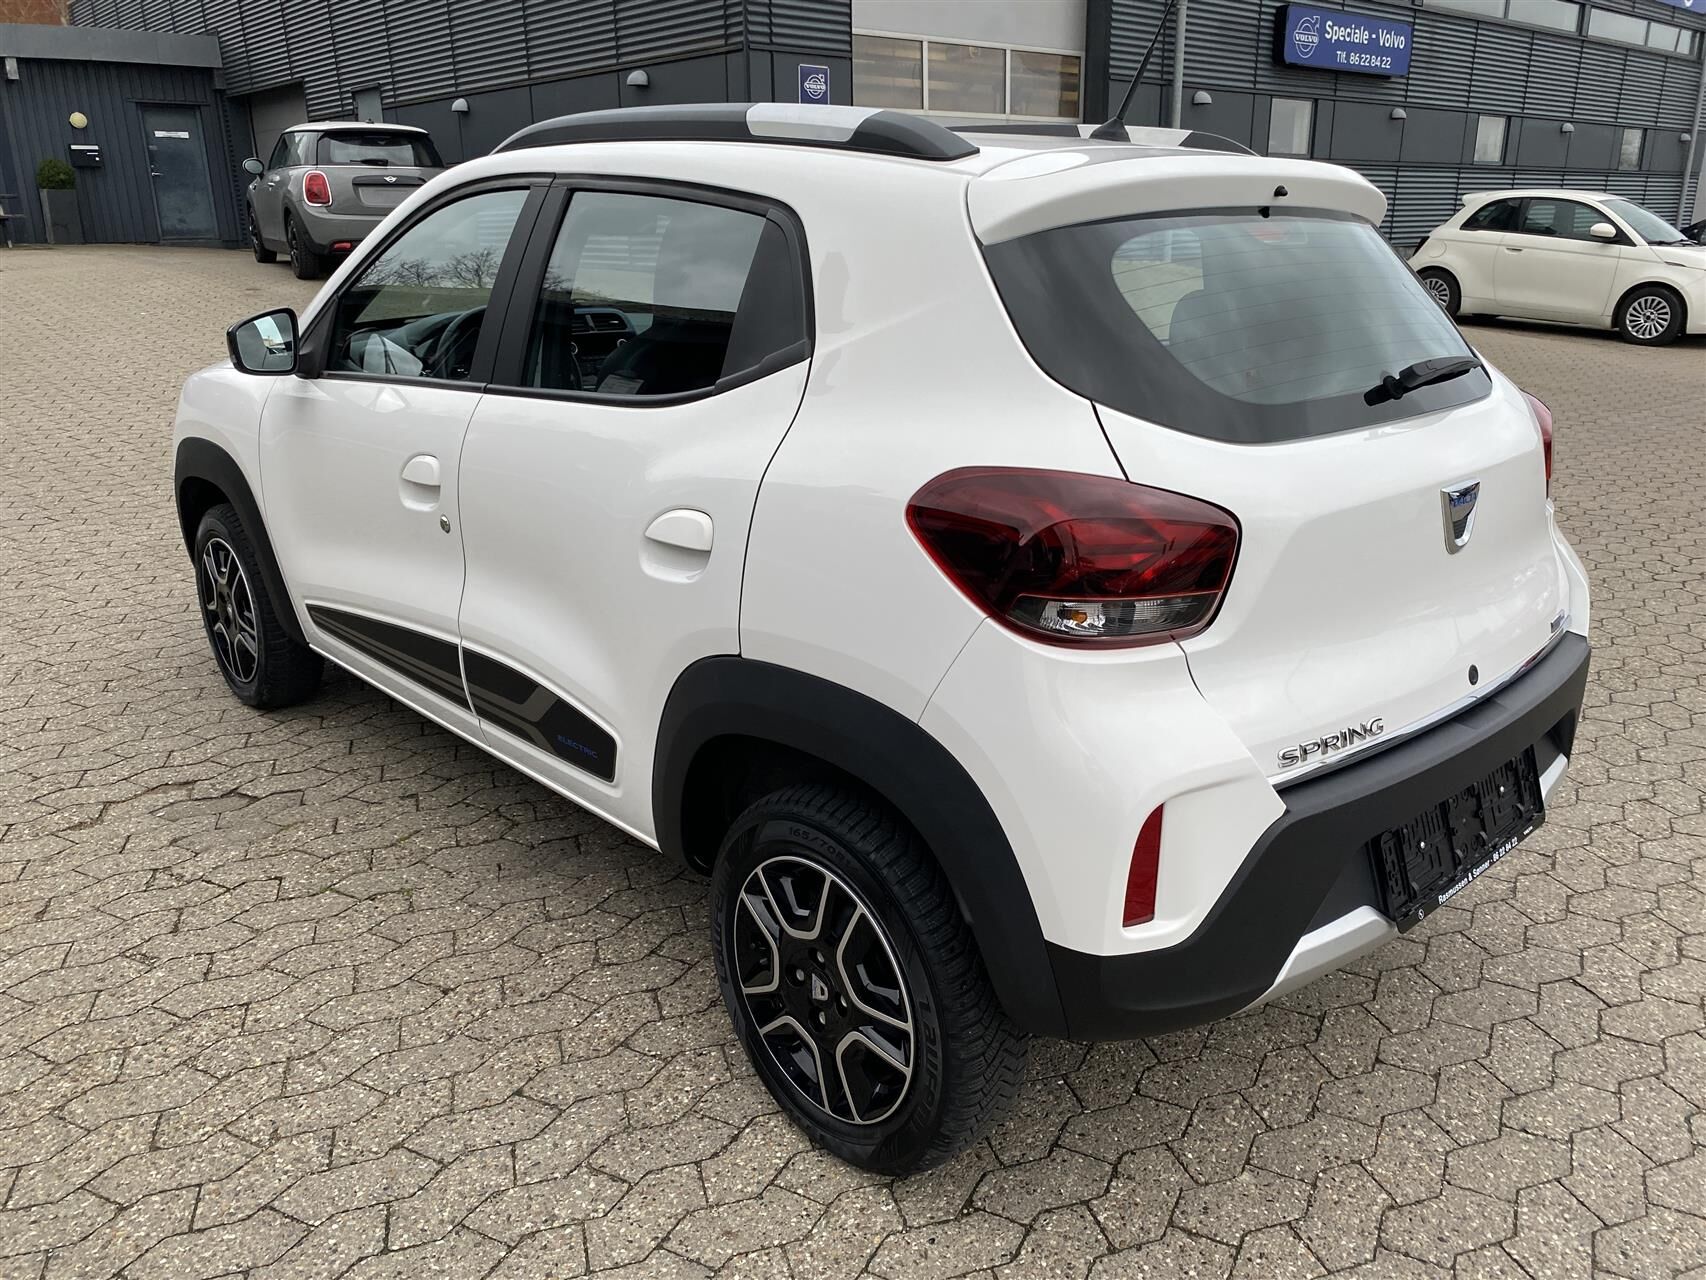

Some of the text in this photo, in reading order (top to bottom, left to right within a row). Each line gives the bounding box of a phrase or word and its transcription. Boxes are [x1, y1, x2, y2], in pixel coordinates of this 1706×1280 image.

[1295, 33, 1318, 43] VOLVO
[1325, 20, 1369, 44] Speciale
[1379, 28, 1405, 49] Volvo
[1336, 50, 1347, 64] Tlf.
[1277, 716, 1384, 769] SPRING
[1438, 878, 1468, 904] Rasmussen
